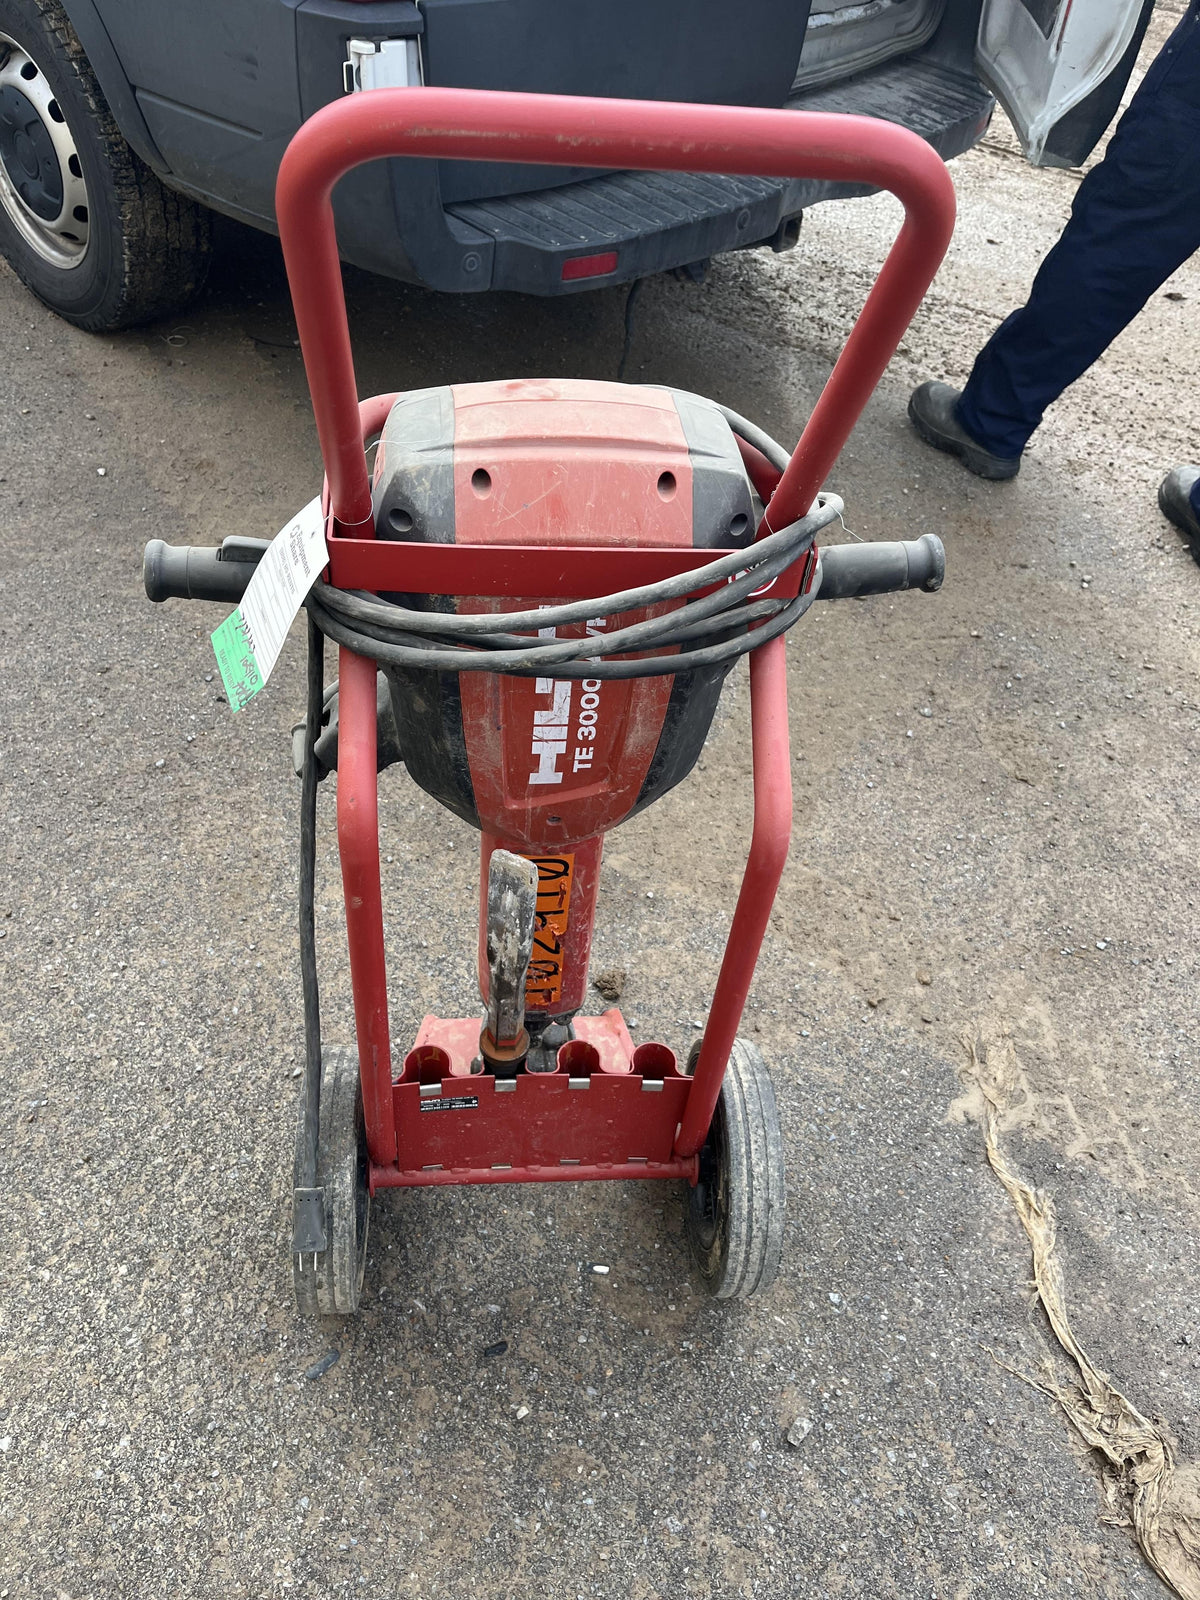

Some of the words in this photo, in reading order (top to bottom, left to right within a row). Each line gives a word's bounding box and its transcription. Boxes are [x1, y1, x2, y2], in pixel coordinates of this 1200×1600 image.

[289, 538, 300, 567] Share
[295, 530, 311, 579] Equipment
[528, 604, 572, 785] HIL
[572, 746, 594, 773] TE
